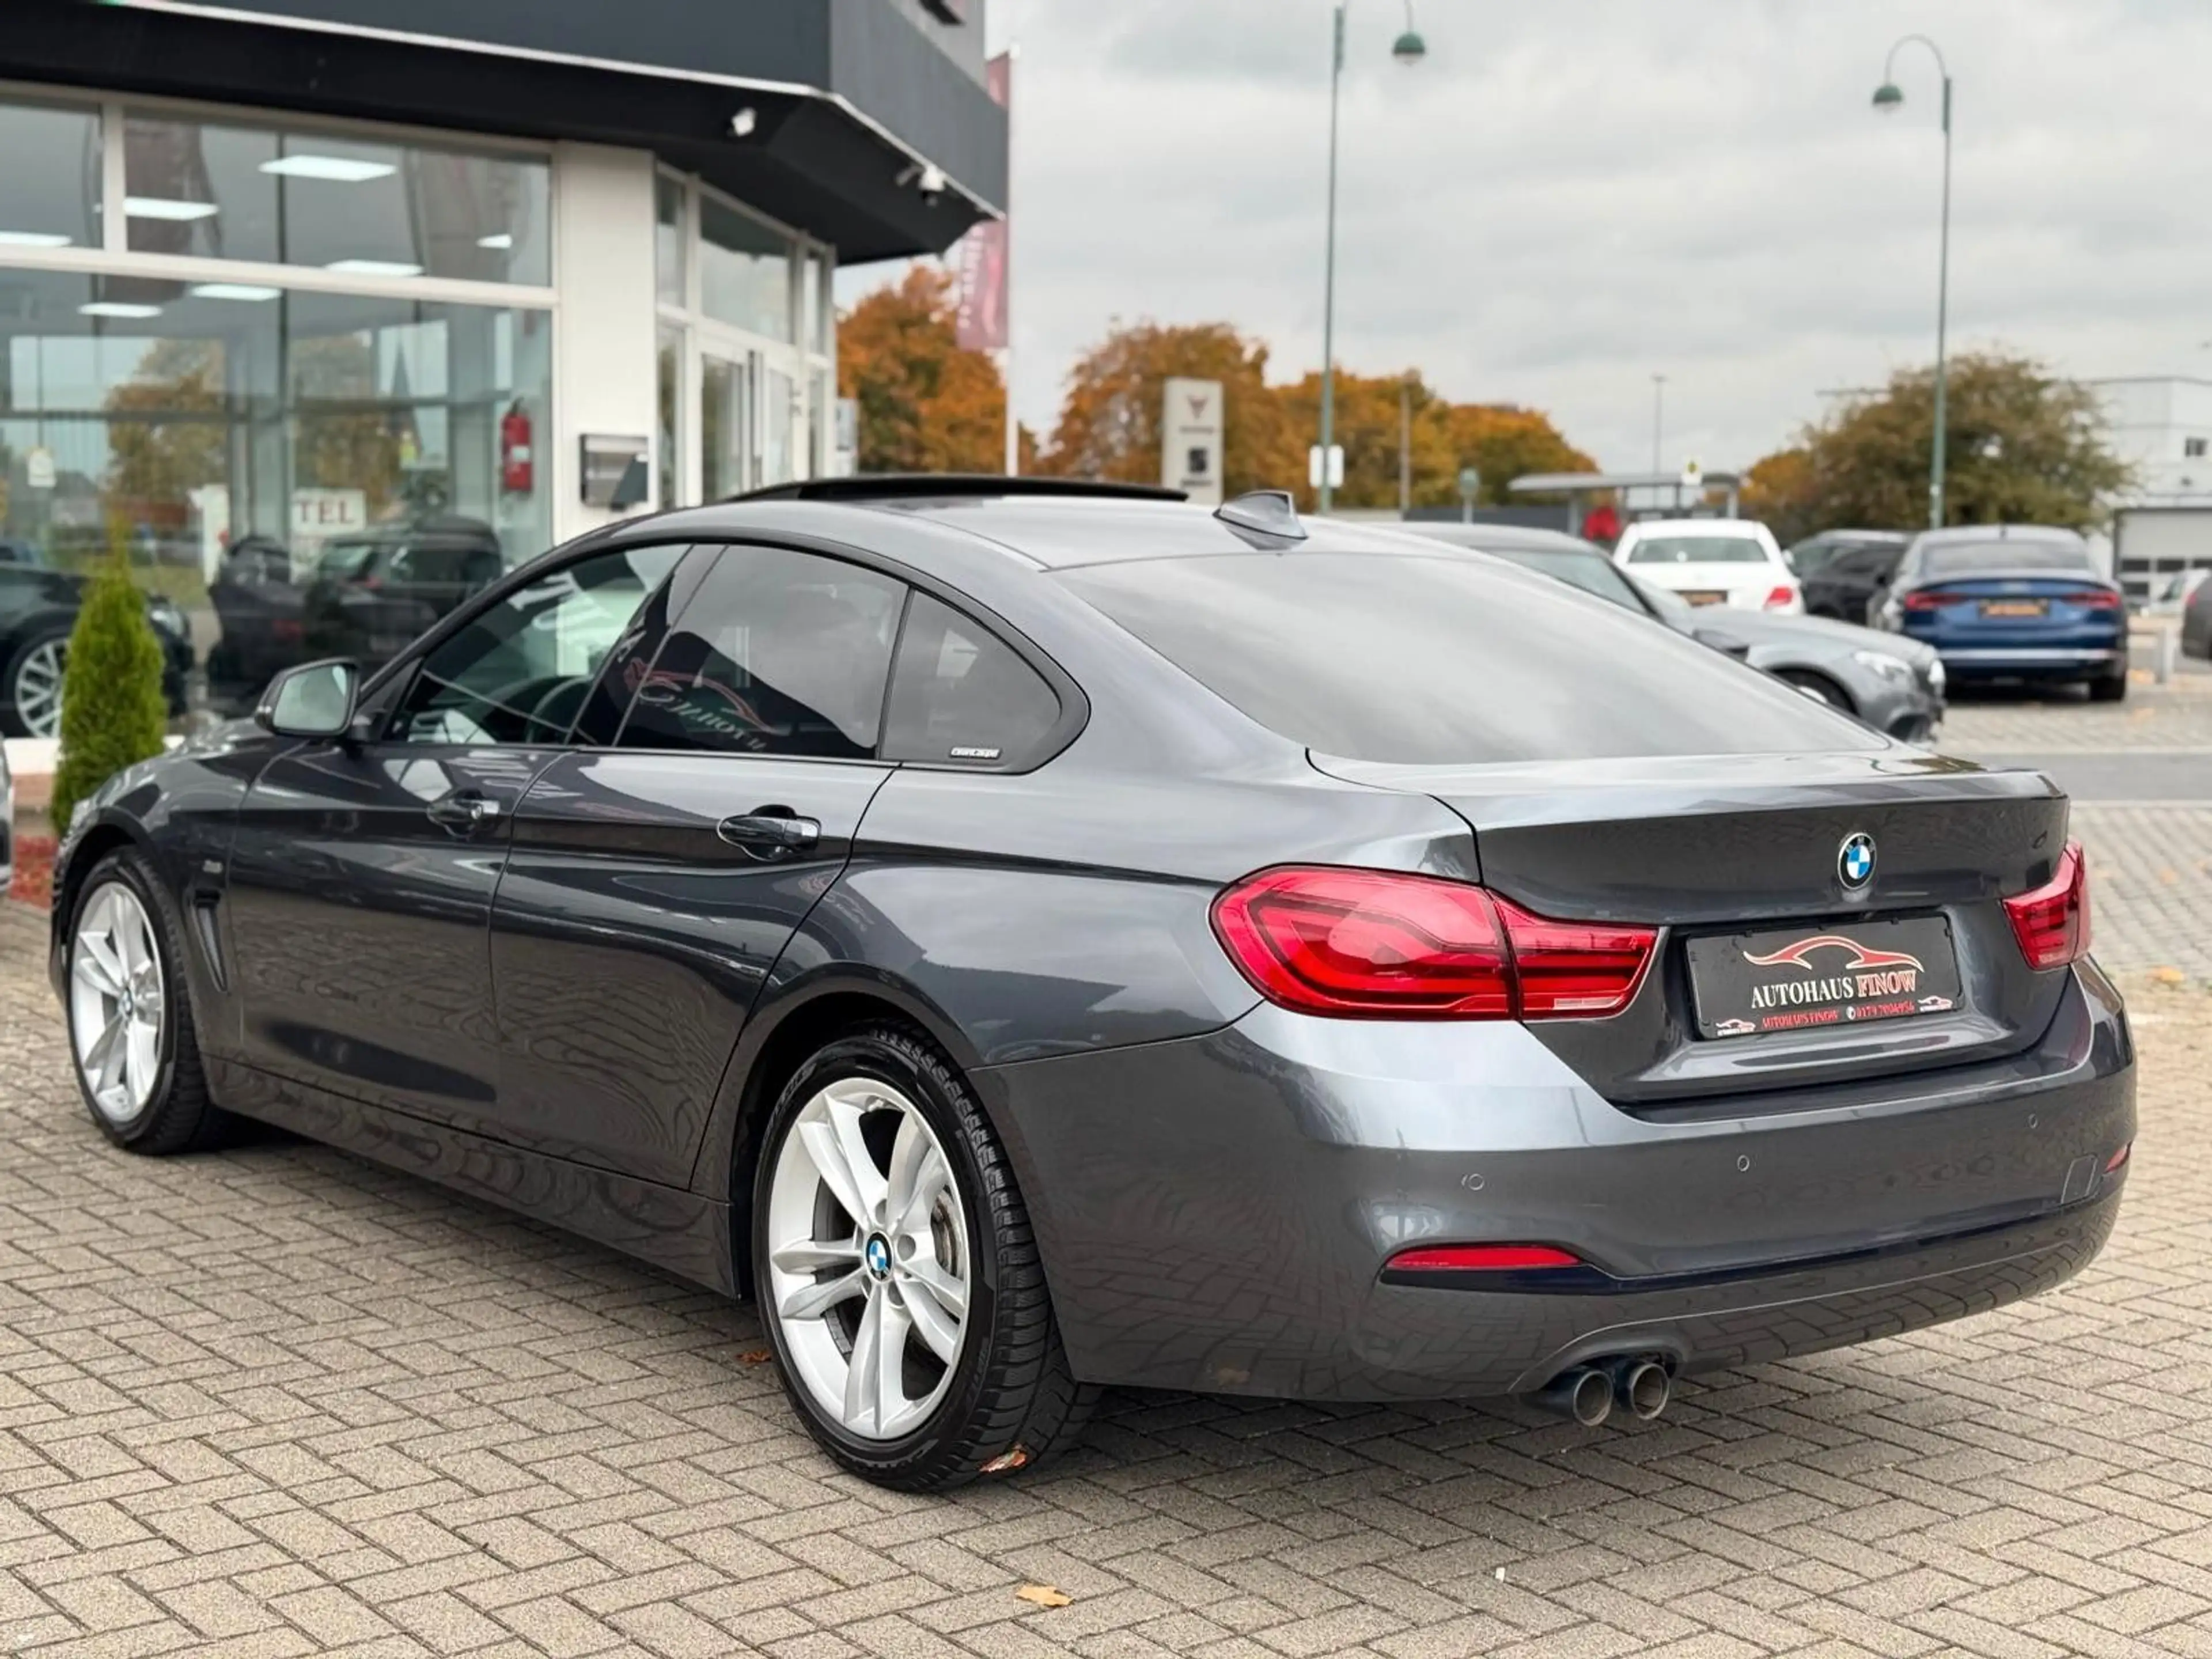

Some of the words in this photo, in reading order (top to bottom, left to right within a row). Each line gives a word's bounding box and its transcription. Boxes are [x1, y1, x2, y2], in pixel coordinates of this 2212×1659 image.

[295, 499, 355, 525] TEL
[1751, 977, 1854, 1008] AUTOHAUS
[1855, 970, 1917, 998] FINOW
